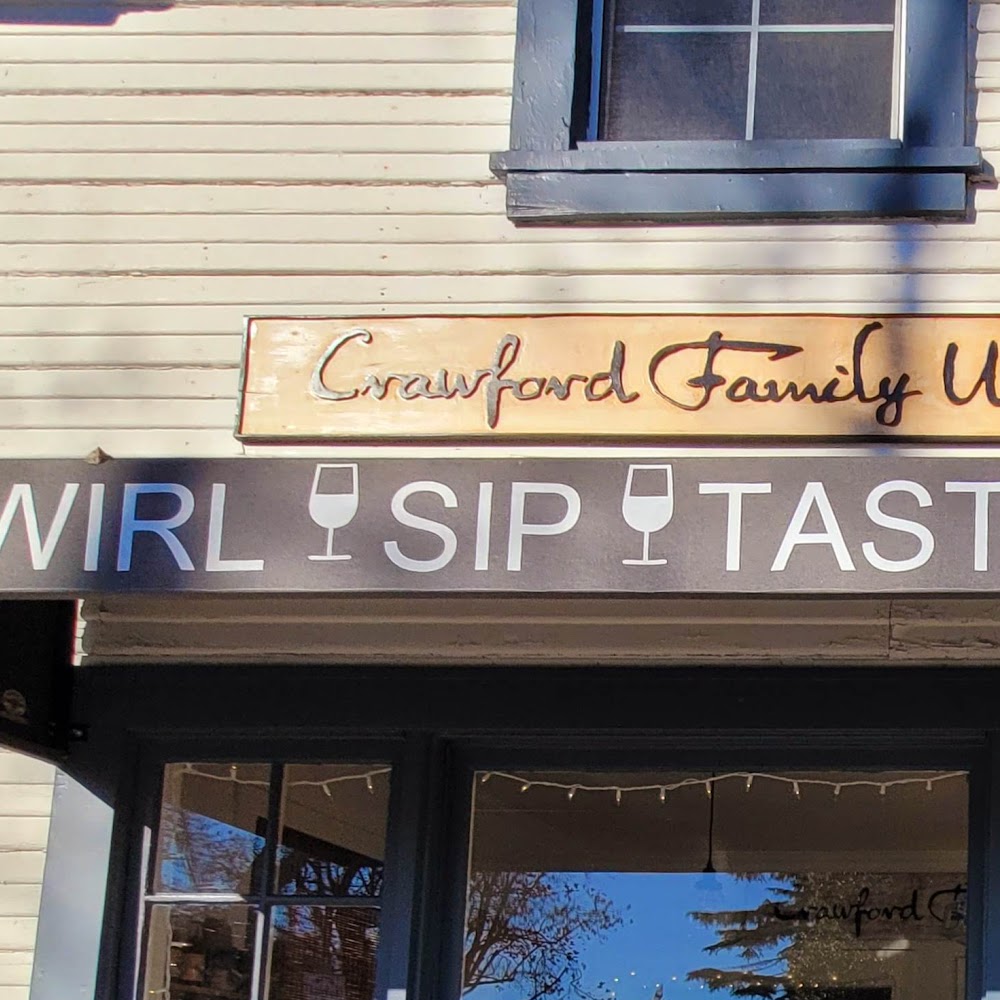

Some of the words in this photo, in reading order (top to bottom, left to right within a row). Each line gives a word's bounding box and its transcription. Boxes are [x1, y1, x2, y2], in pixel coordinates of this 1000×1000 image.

[311, 328, 640, 430] Crawford
[648, 321, 923, 426] Family
[0, 483, 265, 573] WIRL
[383, 480, 582, 573] SIP
